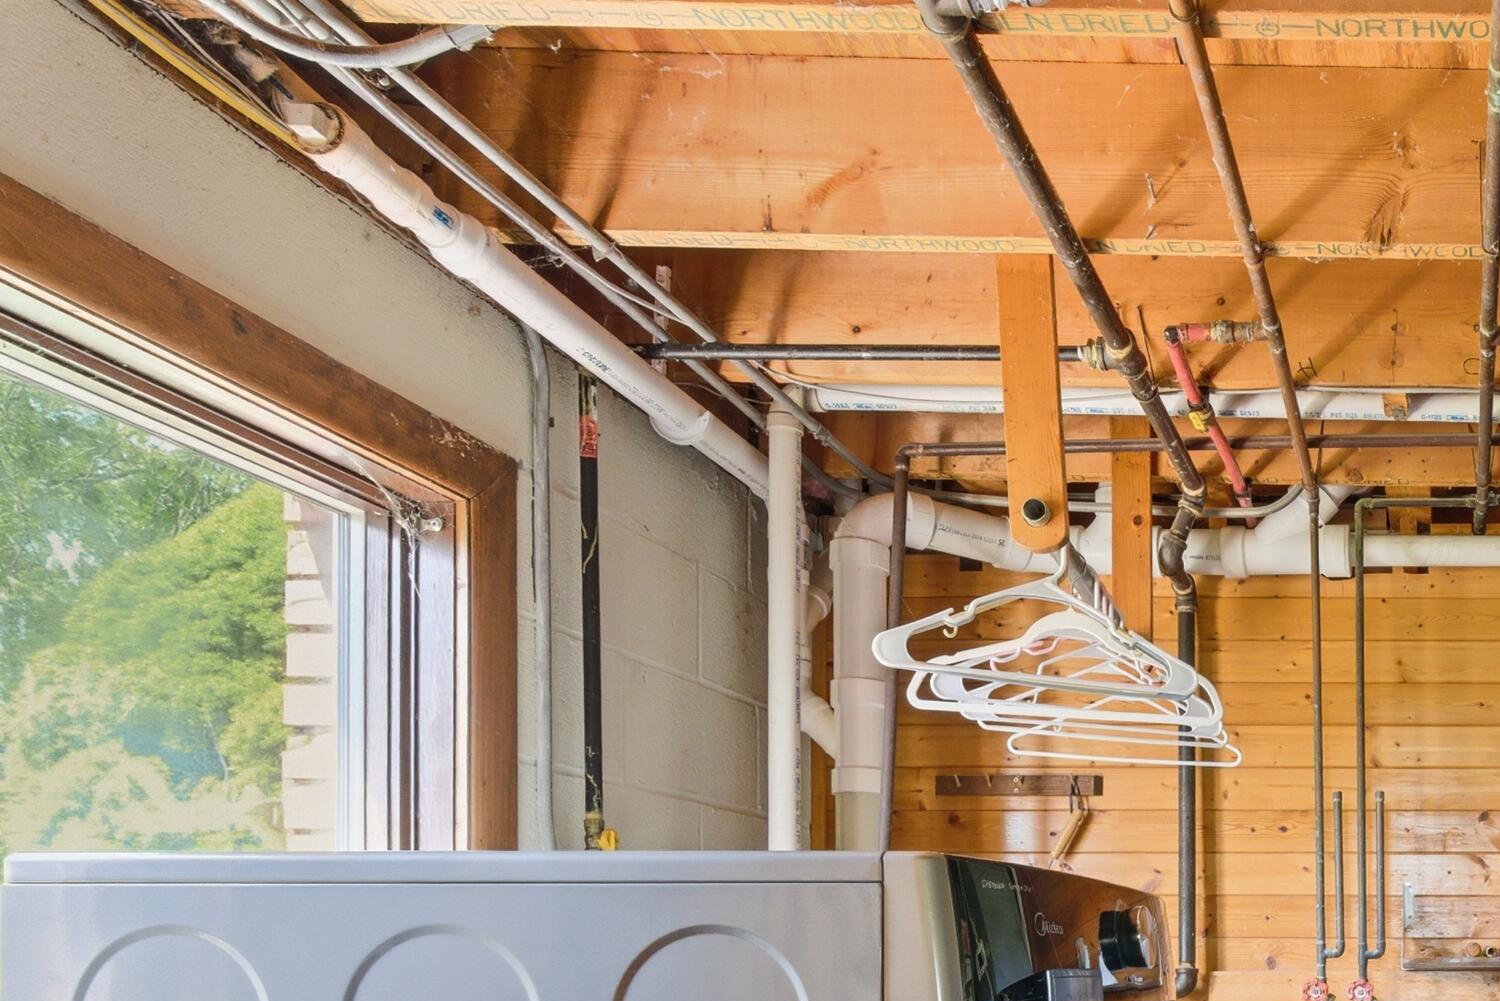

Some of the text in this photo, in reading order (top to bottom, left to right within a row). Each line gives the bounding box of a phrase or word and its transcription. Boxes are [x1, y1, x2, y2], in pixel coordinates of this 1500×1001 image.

[692, 8, 922, 32] NORTHWOOD
[1060, 14, 1171, 34] DRIED
[844, 237, 1016, 252] NORTHWOOD
